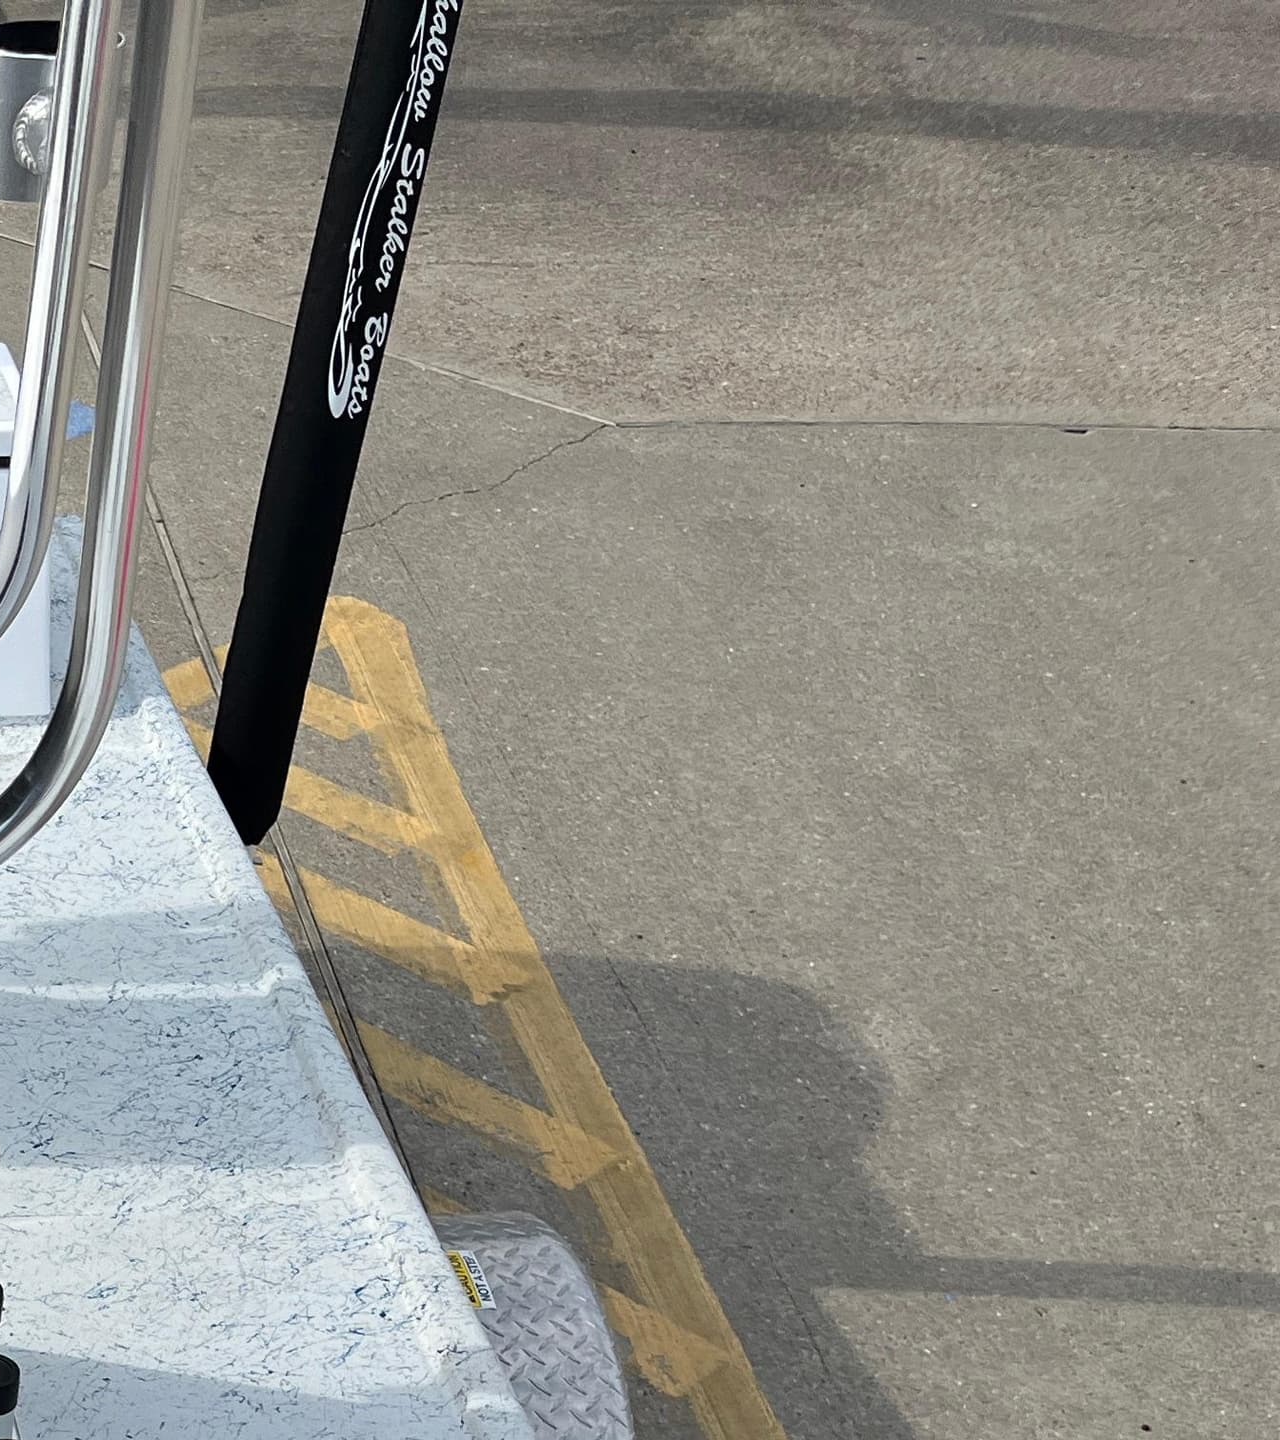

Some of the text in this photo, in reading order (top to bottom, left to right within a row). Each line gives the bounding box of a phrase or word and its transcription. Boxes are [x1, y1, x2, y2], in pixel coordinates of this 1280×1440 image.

[346, 0, 458, 419] hallow Stalker Boats
[463, 1255, 481, 1274] STEP
[475, 1282, 492, 1302] NOT
